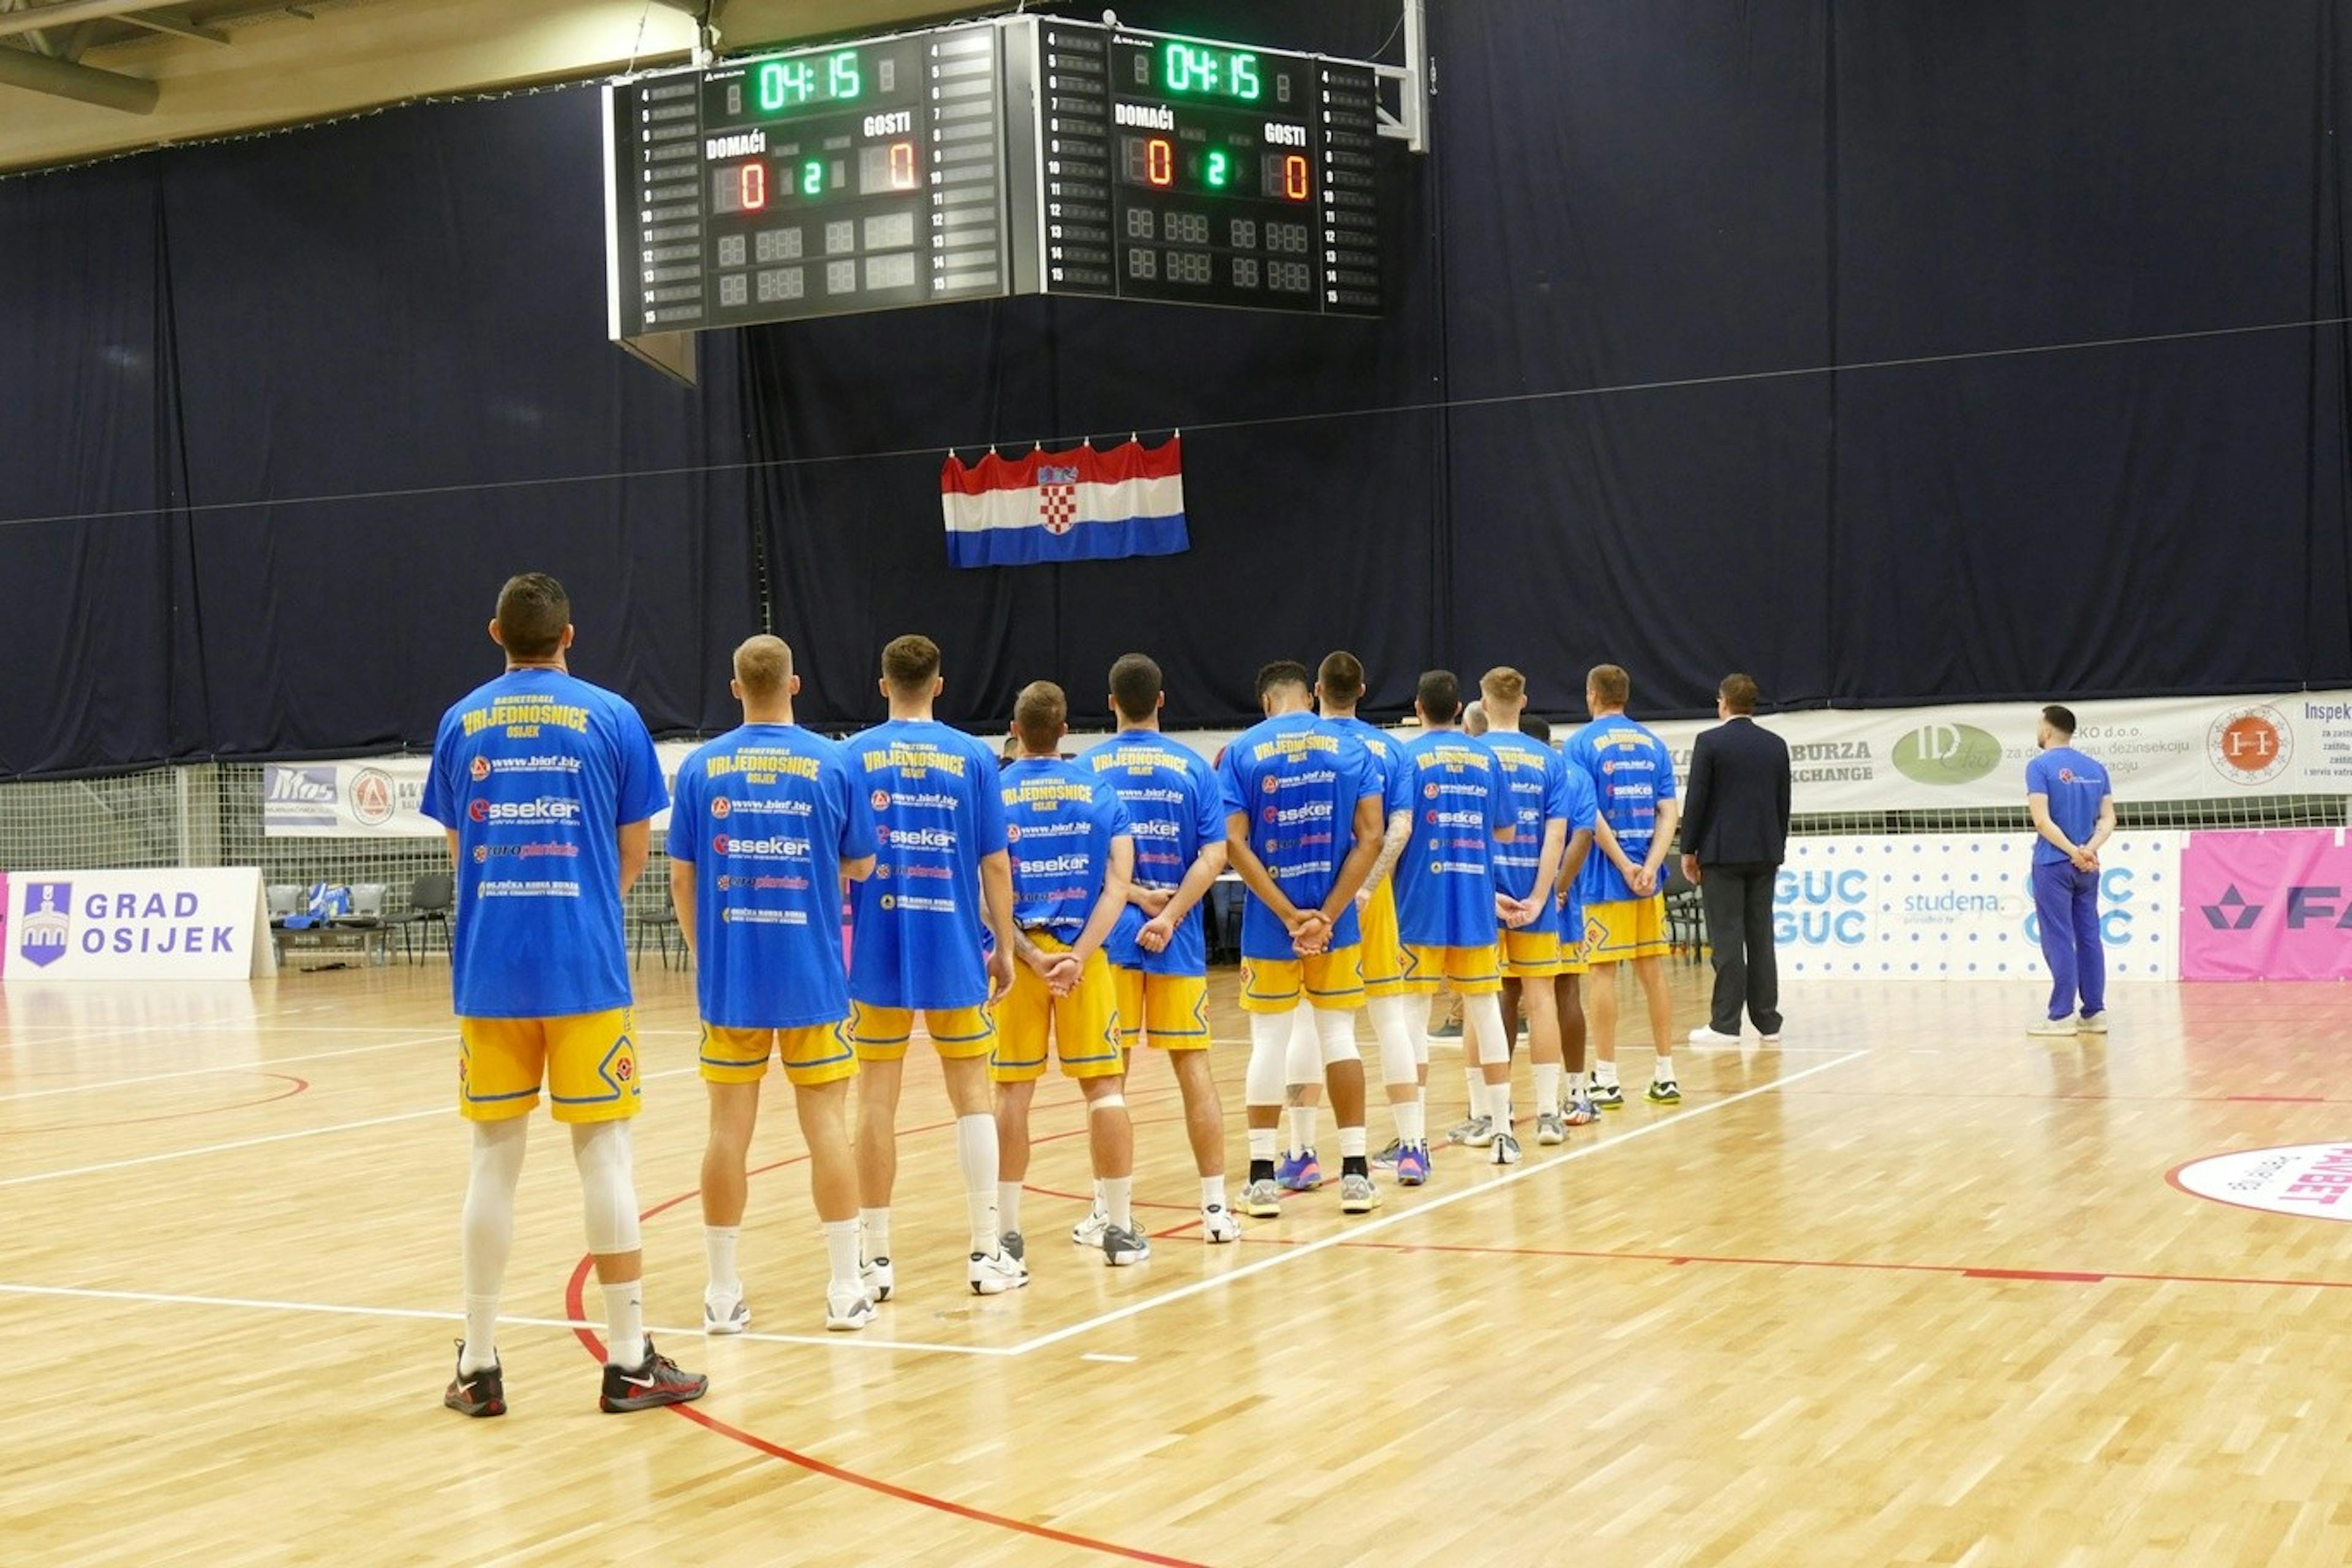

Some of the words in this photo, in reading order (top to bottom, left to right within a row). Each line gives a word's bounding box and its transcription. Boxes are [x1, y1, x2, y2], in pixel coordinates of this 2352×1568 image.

[1047, 32, 1055, 46] 4
[930, 43, 939, 58] 4
[1048, 54, 1057, 68] 5
[932, 64, 940, 78] 5
[1166, 43, 1259, 99] 04:15
[1321, 70, 1329, 83] 4
[761, 51, 860, 110] 04:15
[1049, 75, 1057, 89] 6
[932, 86, 940, 100] 6
[1051, 97, 1058, 110] 7
[934, 107, 940, 120] 7
[1115, 104, 1174, 130] DOMAĆI
[864, 111, 911, 137] GOSTI
[1051, 118, 1058, 132] 8
[1264, 122, 1306, 147] GOSTI
[1325, 130, 1332, 143] 7
[706, 129, 766, 160] DOMAĆI
[1051, 139, 1060, 153] 9
[644, 149, 650, 162] 7
[1149, 140, 1170, 184] 0
[890, 143, 915, 189] 0
[1048, 160, 1060, 175] 10
[1208, 152, 1226, 184] 2
[804, 162, 821, 194] 2
[1286, 155, 1307, 199] 0
[742, 164, 764, 209] 0
[1050, 182, 1060, 195] 11
[932, 192, 943, 205] 11
[1049, 203, 1061, 217] 12
[932, 213, 943, 226] 12
[643, 229, 653, 243] 11
[1050, 225, 1062, 239] 13
[1325, 230, 1335, 243] 12
[932, 233, 944, 248] 13
[642, 249, 654, 263] 12
[1051, 246, 1063, 260] 14
[933, 255, 944, 269] 14
[1051, 267, 1063, 281] 15
[933, 276, 945, 290] 15
[462, 704, 589, 737] VRIJEDNOSNICE
[1790, 741, 1872, 762] BURZA
[707, 755, 820, 782] VRIJEDNOSNICE
[1790, 766, 1873, 783] XCHANGE
[469, 798, 581, 823] esseker
[1129, 820, 1180, 837] seker
[714, 833, 811, 856] esseker
[1775, 869, 1868, 905] GUC
[85, 892, 198, 919] GRAD
[1773, 910, 1867, 945] GUC
[81, 926, 235, 954] OSIJEK
